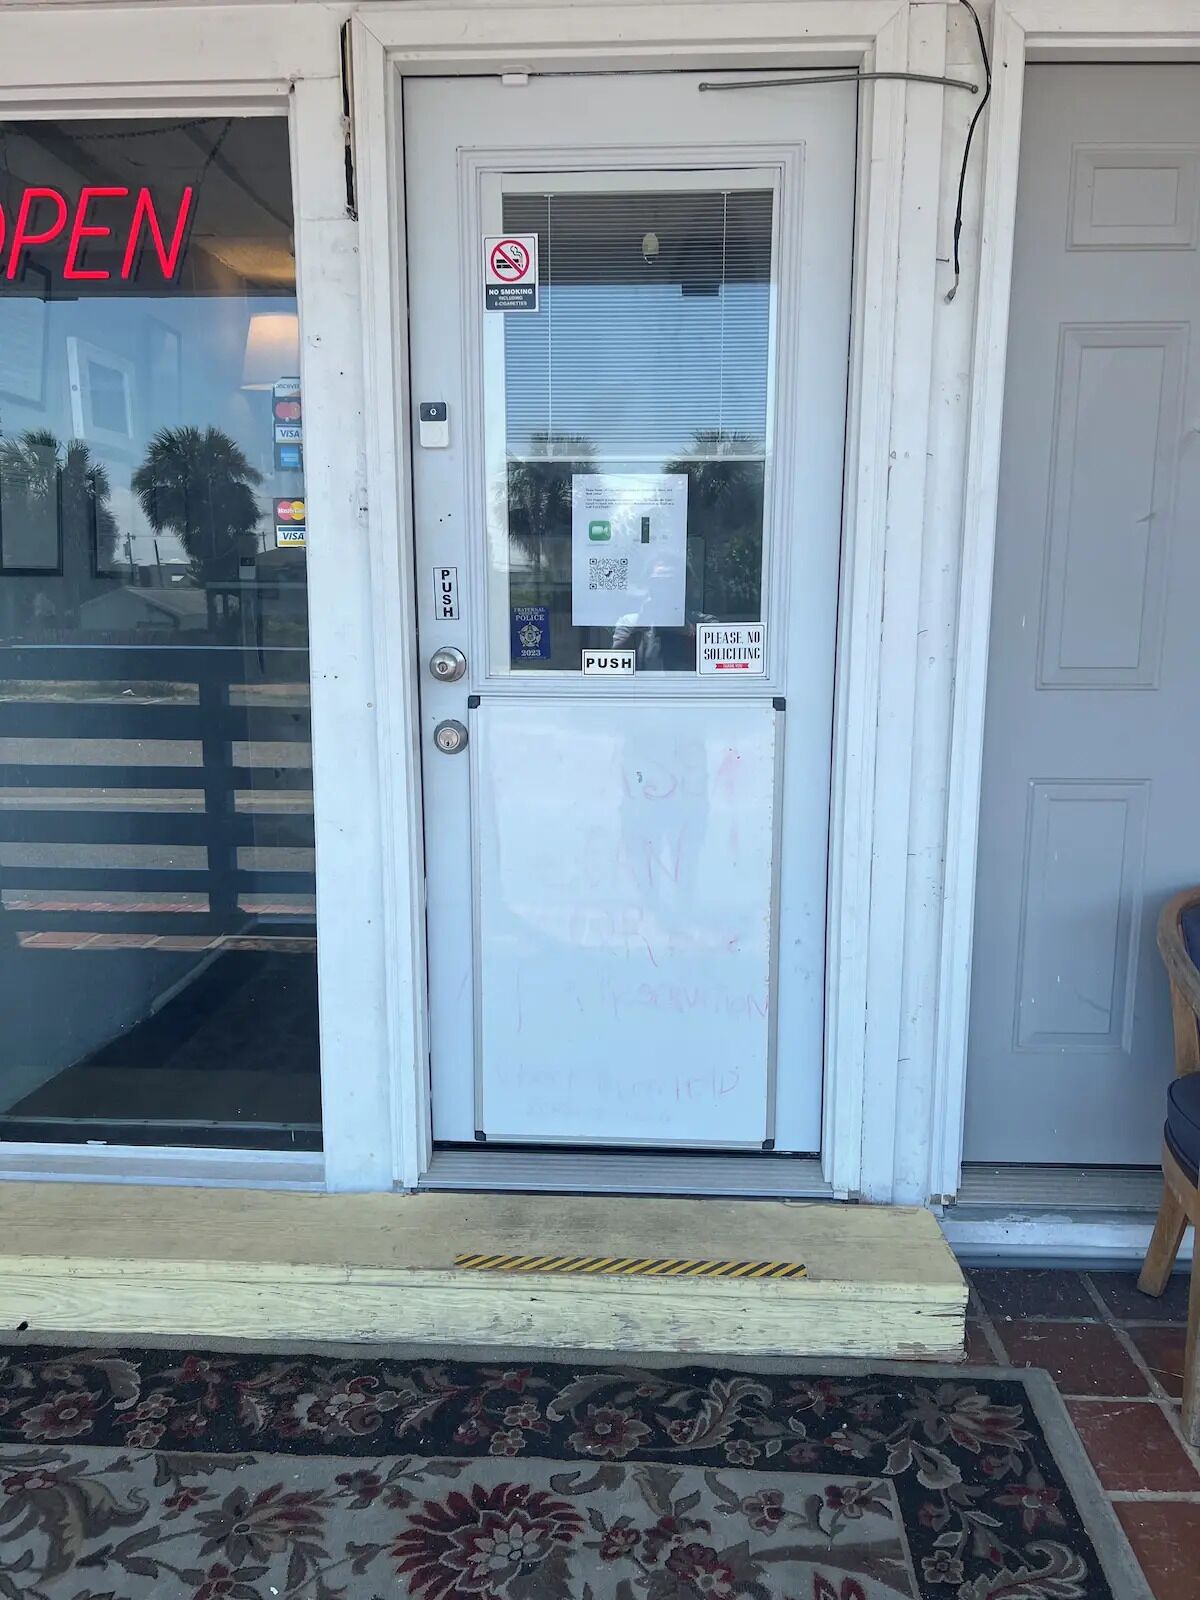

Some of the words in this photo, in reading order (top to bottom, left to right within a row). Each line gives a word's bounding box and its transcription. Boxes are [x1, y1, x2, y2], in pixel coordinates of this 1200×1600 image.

[0, 186, 193, 280] PEN
[280, 429, 300, 438] VISA
[282, 532, 305, 540] VISA
[441, 569, 453, 617] PUSH
[747, 631, 760, 643] NO
[520, 649, 541, 657] 2023
[704, 647, 760, 660] SOLICITING
[586, 658, 632, 668] PUSH
